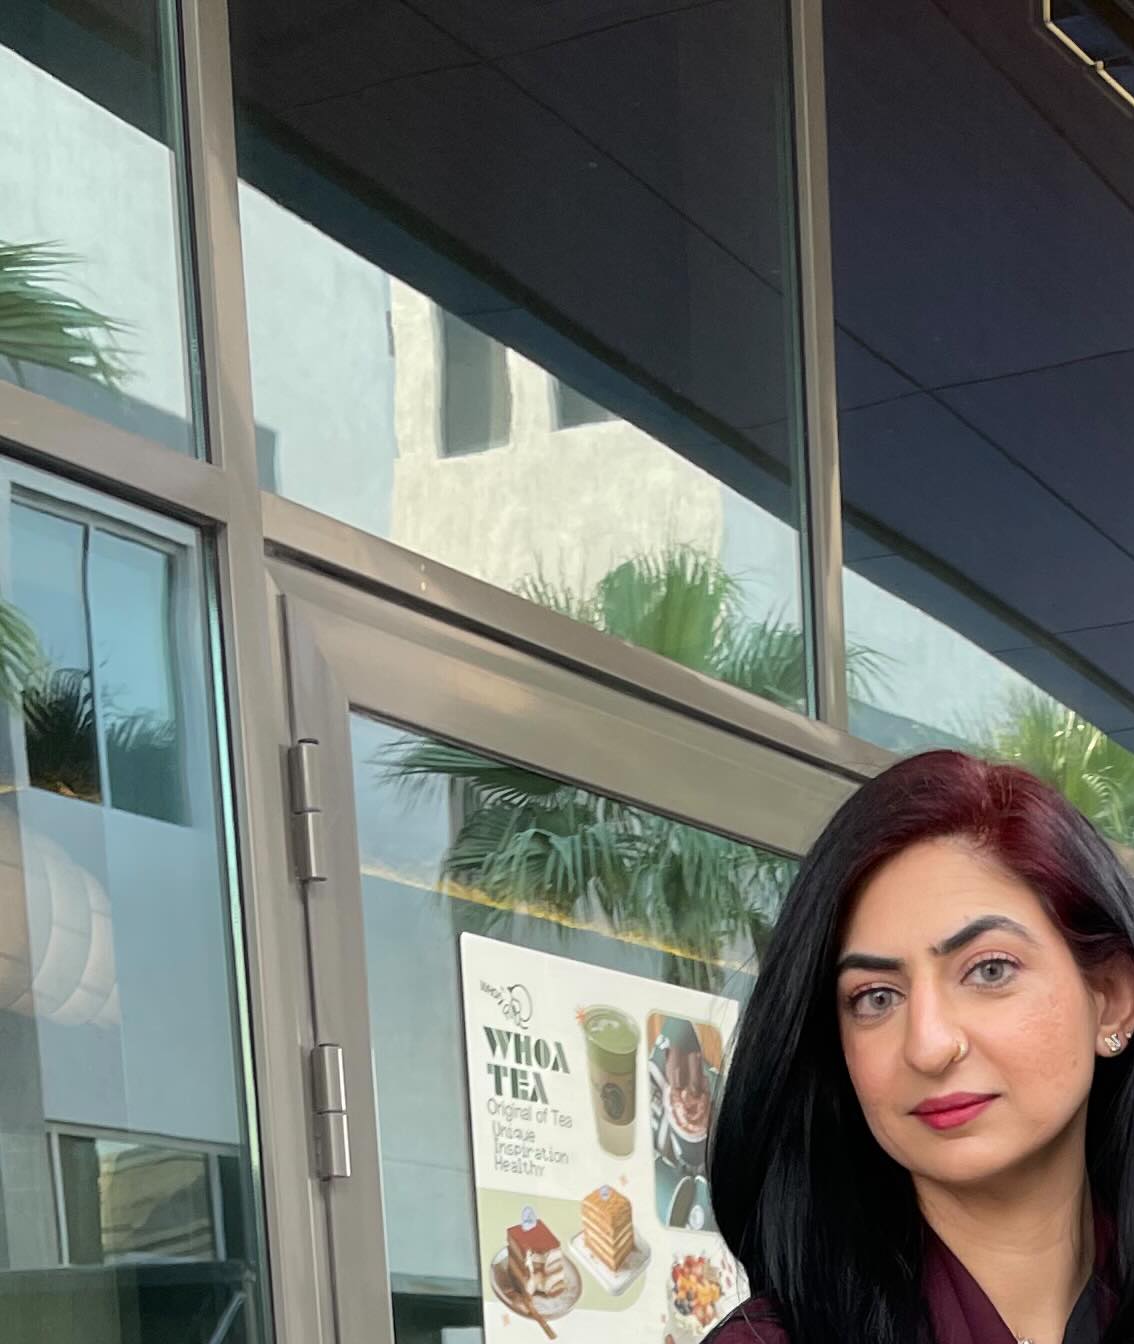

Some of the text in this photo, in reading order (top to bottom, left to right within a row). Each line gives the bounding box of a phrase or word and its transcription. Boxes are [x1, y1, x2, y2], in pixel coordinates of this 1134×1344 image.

[483, 1026, 570, 1075] WHOA
[487, 1063, 549, 1105] TEA
[487, 1097, 532, 1123] Original
[535, 1106, 548, 1124] of
[492, 1119, 536, 1143] Unique
[495, 1136, 569, 1165] Inspiration
